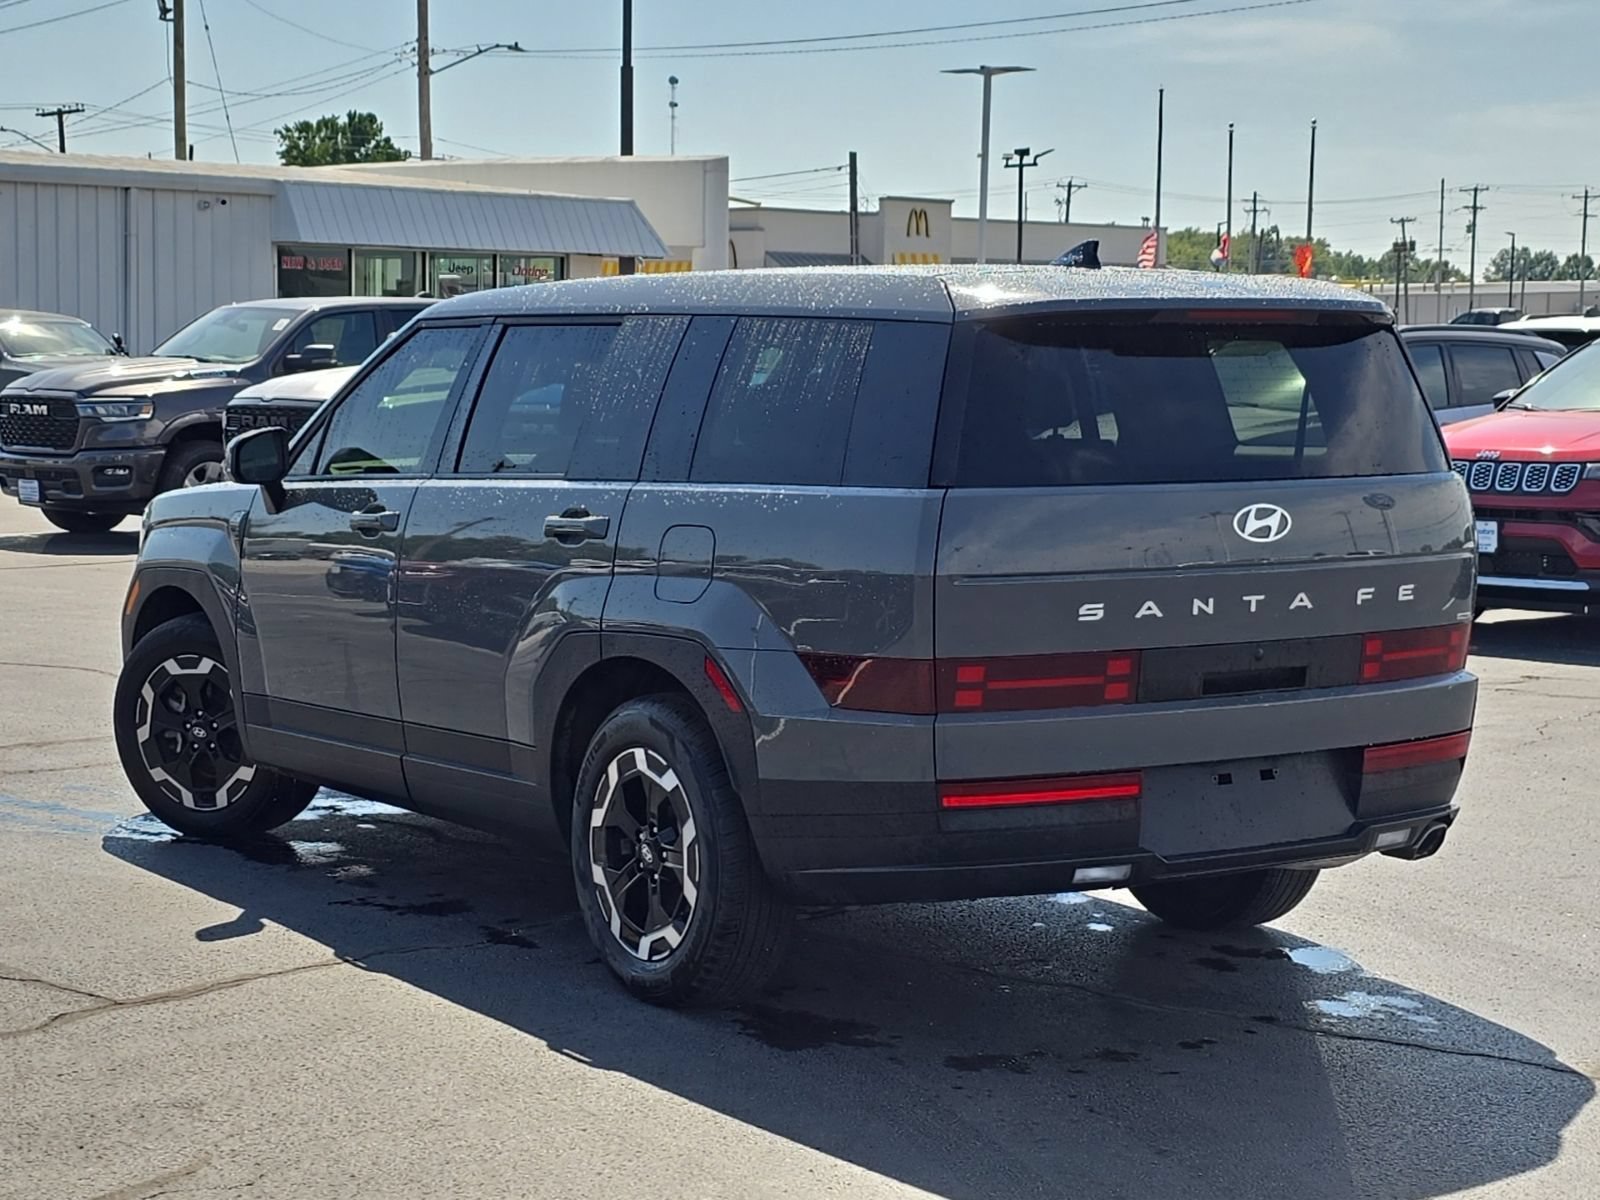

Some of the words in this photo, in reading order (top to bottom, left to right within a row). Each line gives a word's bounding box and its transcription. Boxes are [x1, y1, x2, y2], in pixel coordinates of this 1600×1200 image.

[281, 255, 304, 270] NEW
[319, 257, 344, 272] USED
[448, 262, 474, 275] Jeep
[512, 264, 549, 279] Dodge
[9, 403, 48, 415] RAM
[241, 415, 288, 428] RAM
[1475, 449, 1500, 460] Jeep
[1078, 592, 1314, 621] SANTA
[1356, 584, 1416, 605] FE
